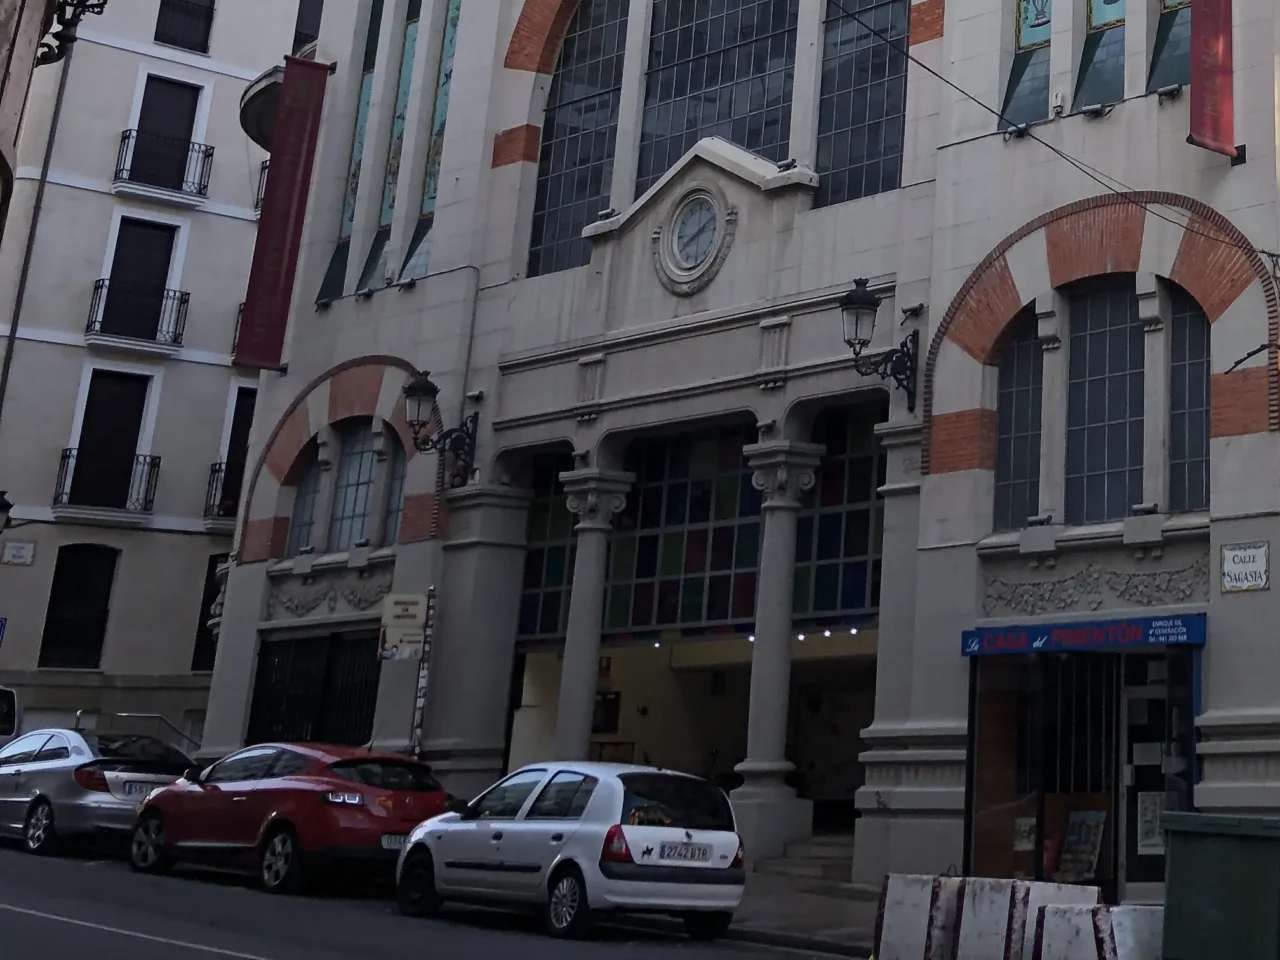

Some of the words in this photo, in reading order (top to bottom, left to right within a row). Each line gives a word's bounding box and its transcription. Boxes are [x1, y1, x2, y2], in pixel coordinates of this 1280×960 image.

[1232, 554, 1257, 565] CALLE
[1226, 570, 1263, 583] SAGASTA
[966, 637, 979, 652] La
[983, 632, 1029, 651] CASA
[1051, 620, 1143, 647] PIMENTÓN
